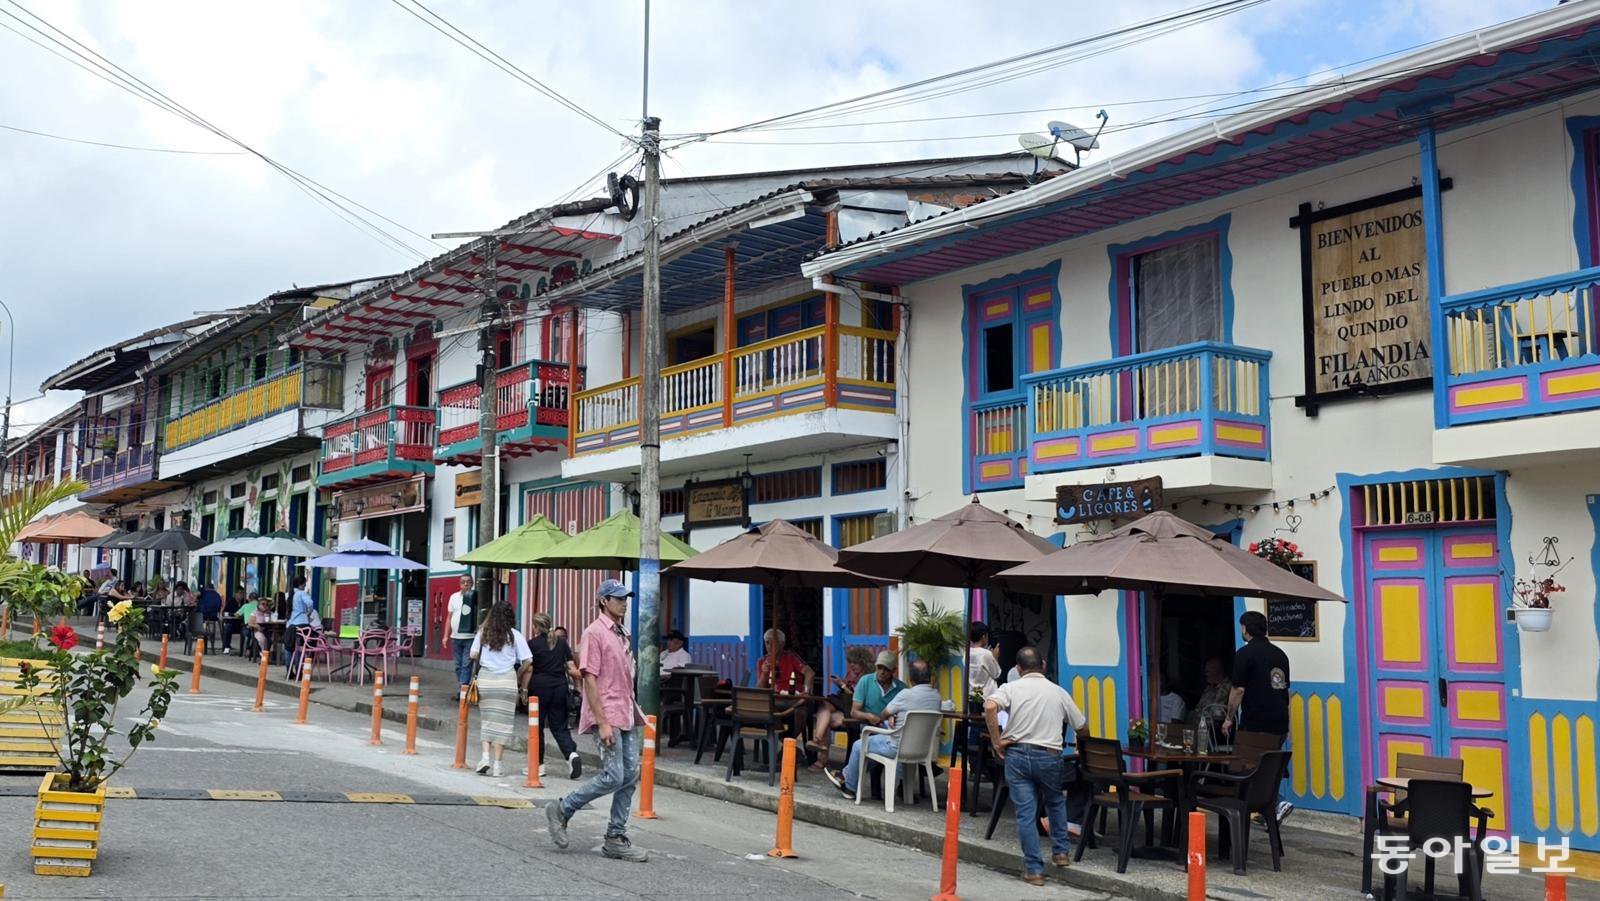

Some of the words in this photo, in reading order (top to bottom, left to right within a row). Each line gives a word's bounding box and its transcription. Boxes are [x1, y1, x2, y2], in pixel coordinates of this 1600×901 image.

[1317, 210, 1422, 249] BIENVENIDOS
[1359, 247, 1381, 263] AL
[1322, 271, 1382, 295] PUEBLO
[1386, 262, 1421, 282] MAS
[1324, 297, 1374, 318] LINDO
[1386, 289, 1419, 307] DEL
[1337, 315, 1408, 341] QUINDIO
[1319, 339, 1430, 375] FILANDIA
[1332, 371, 1362, 389] 144
[1083, 487, 1122, 502] CAFE
[1079, 500, 1138, 517] LICORES
[1407, 513, 1432, 523] 6-08
